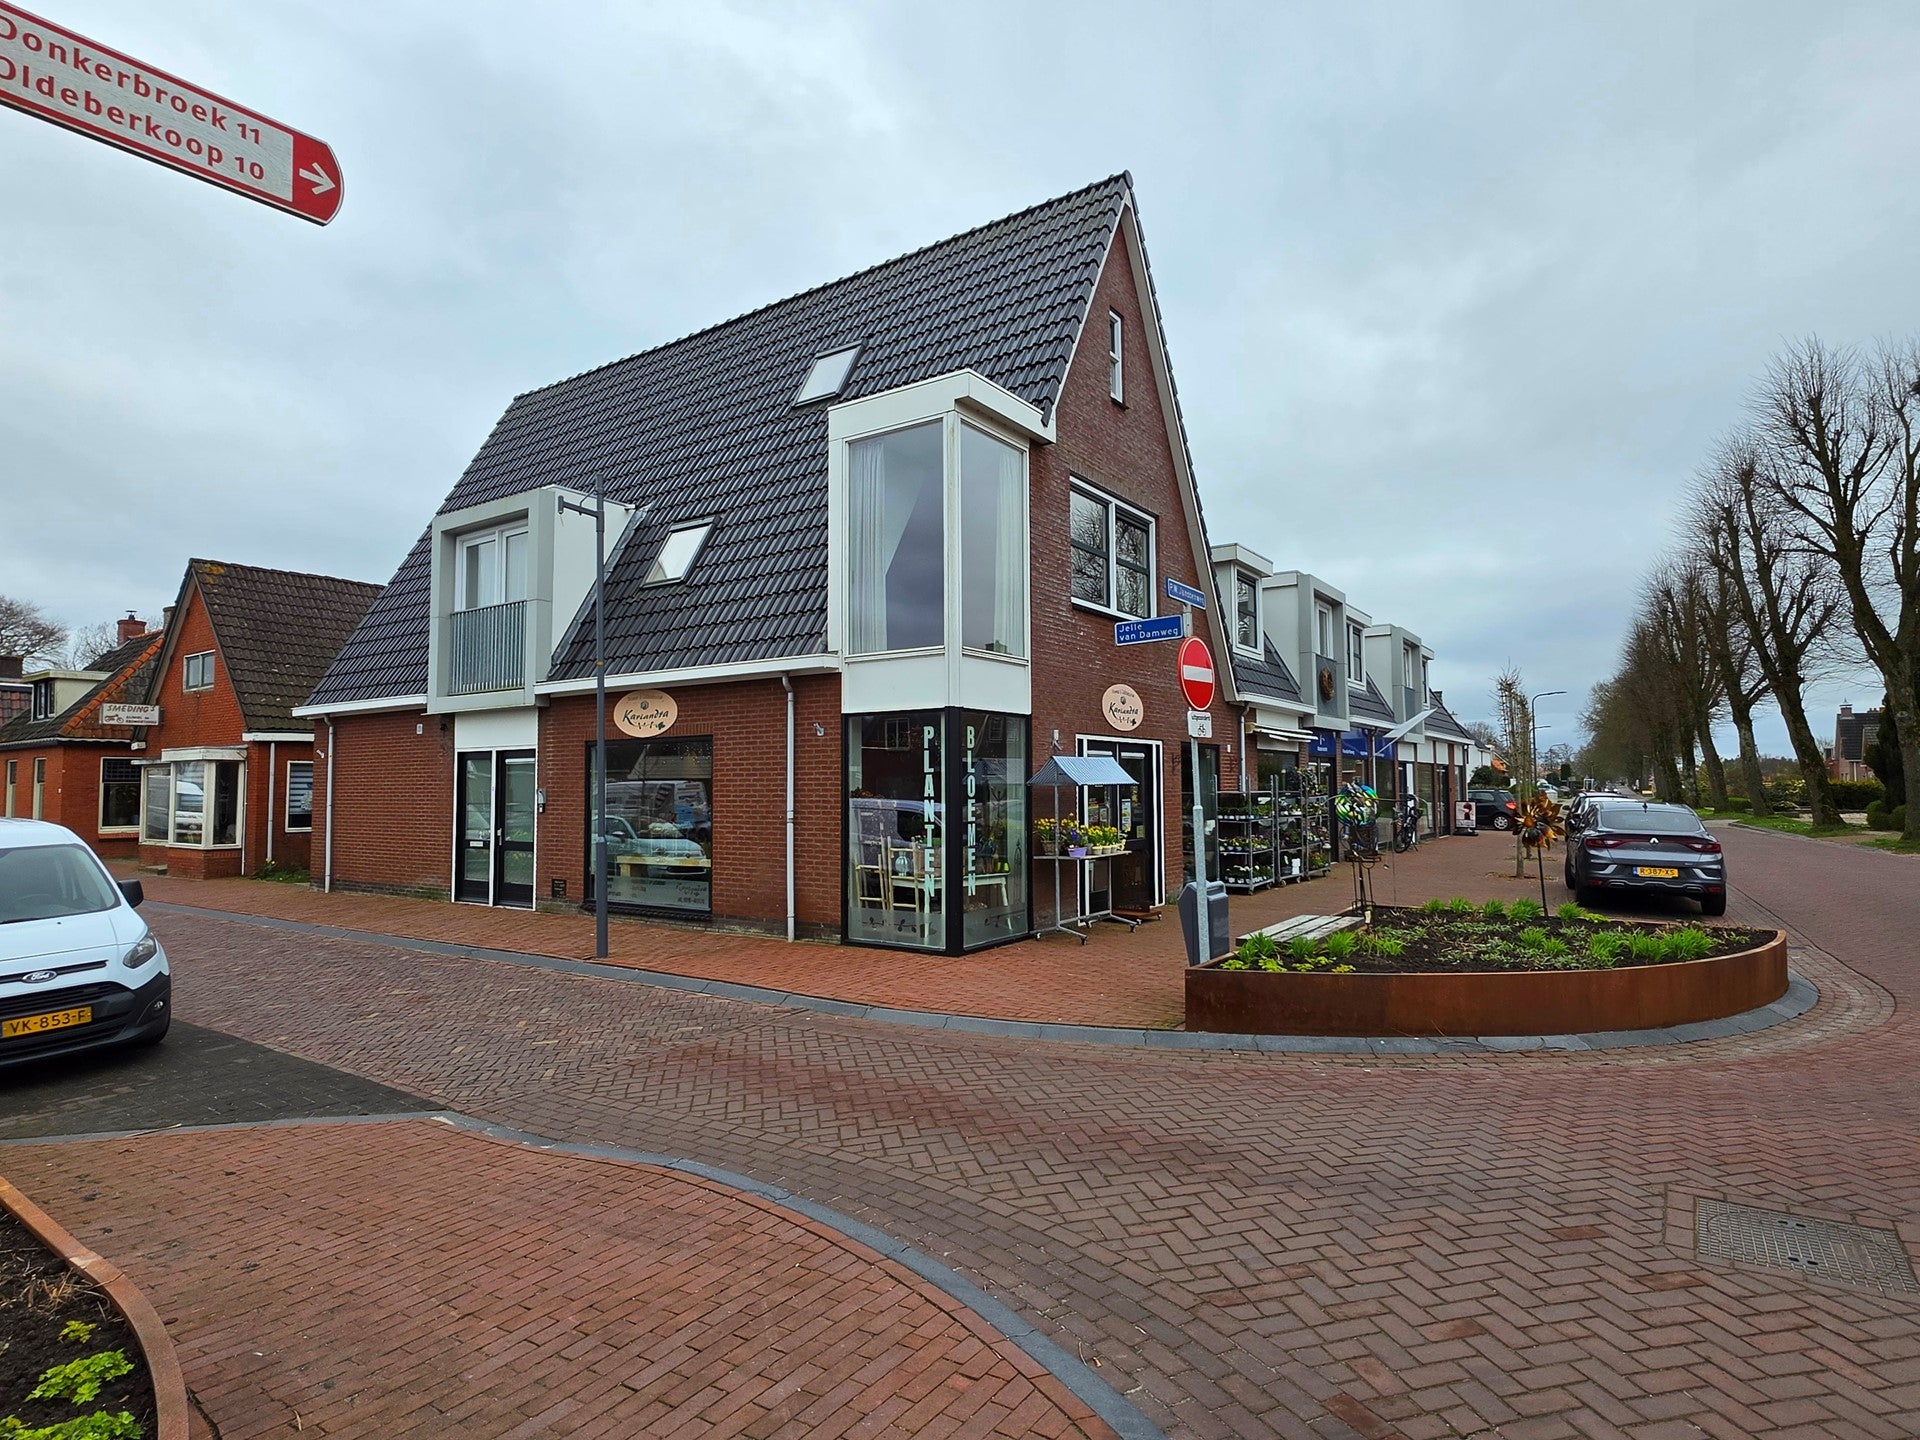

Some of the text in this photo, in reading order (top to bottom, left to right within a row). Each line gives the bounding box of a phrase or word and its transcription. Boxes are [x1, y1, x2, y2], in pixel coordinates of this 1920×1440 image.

[0, 15, 261, 145] Donkerbroek 11
[0, 55, 265, 180] Oldeberkoop 10
[1119, 623, 1143, 633] Jelle
[1119, 628, 1179, 641] van Damweg
[923, 725, 935, 898] PLANTEN
[966, 725, 976, 897] BLOEMEN
[9, 1009, 86, 1034] VK-853-F
